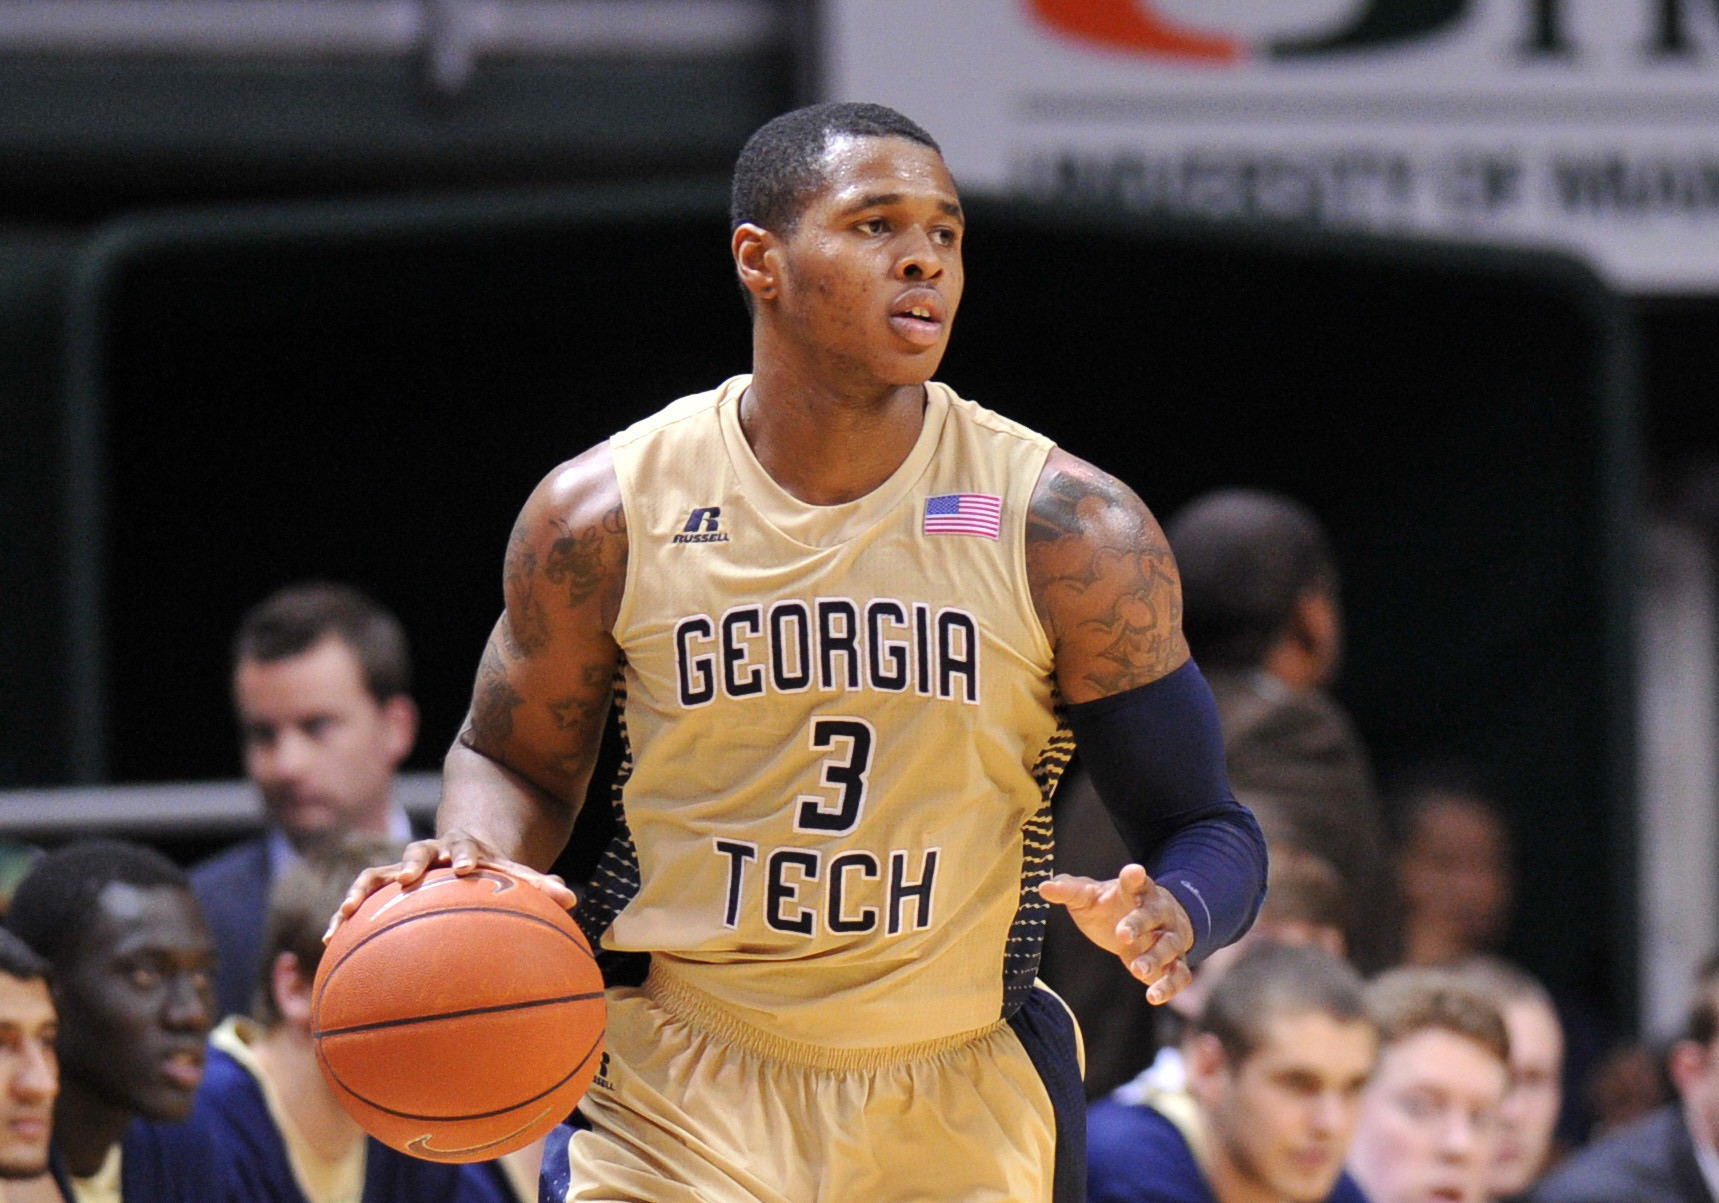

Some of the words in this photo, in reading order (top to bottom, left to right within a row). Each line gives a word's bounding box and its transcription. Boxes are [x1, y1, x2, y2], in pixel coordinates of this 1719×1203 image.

[672, 532, 730, 544] RUSSELL
[674, 597, 980, 709] GEORGIA
[793, 715, 877, 838] 3
[712, 837, 941, 938] TECH
